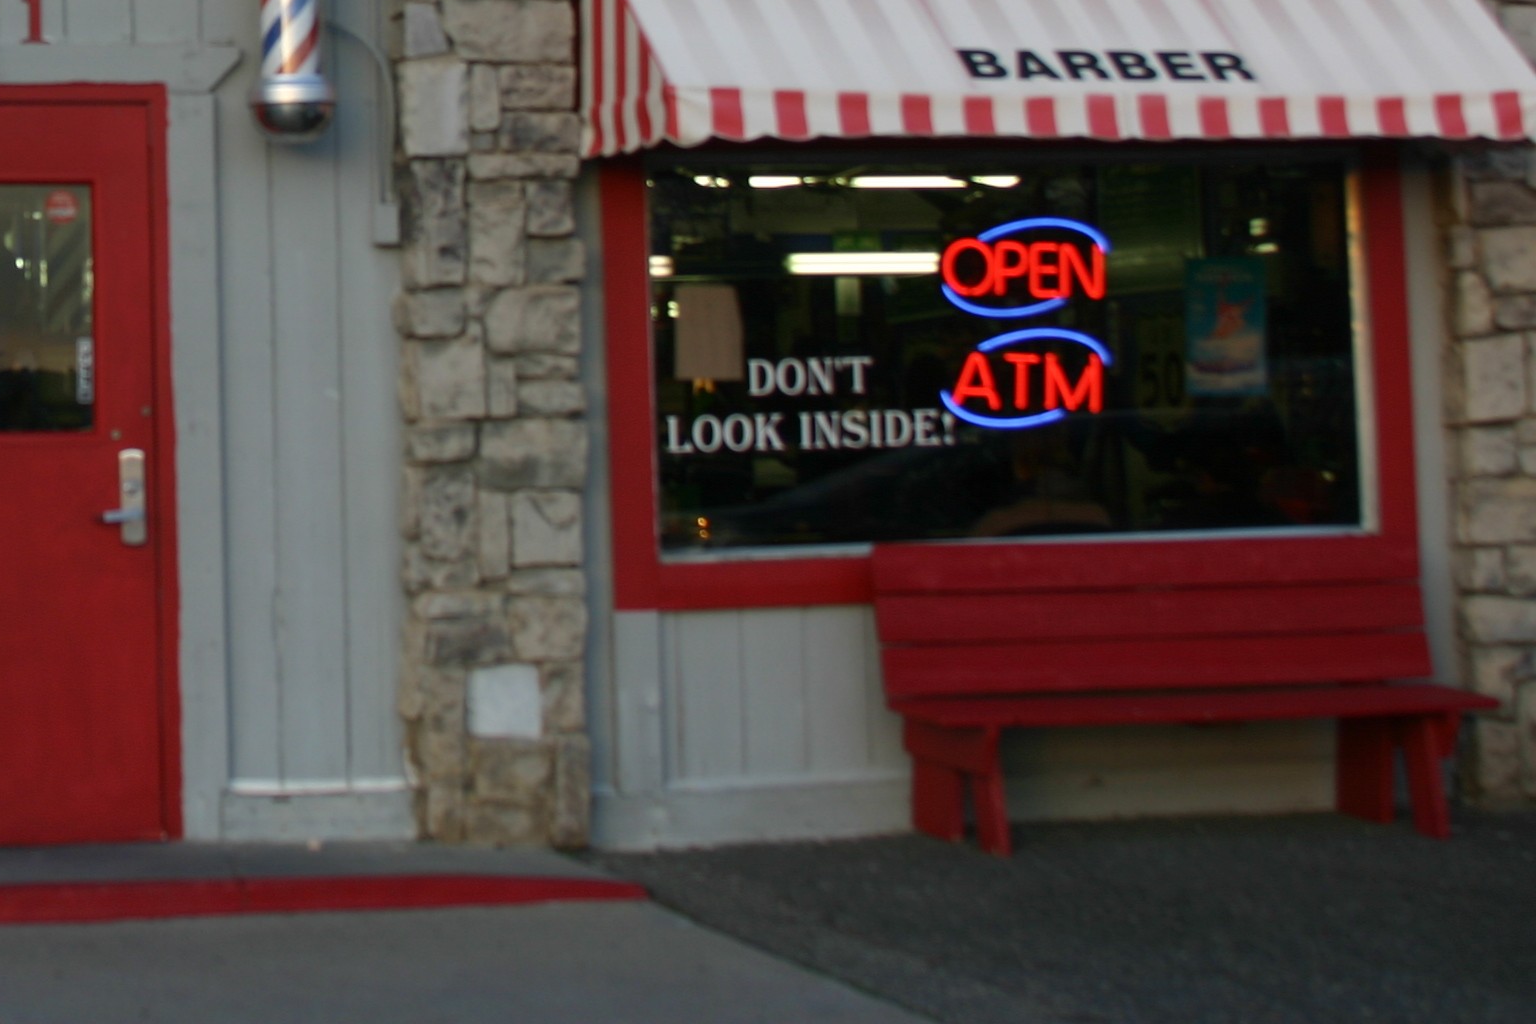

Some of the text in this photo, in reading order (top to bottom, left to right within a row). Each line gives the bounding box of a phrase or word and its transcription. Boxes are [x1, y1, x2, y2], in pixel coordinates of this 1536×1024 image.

[955, 48, 1259, 82] BARBER
[942, 237, 1106, 301] OPEN
[747, 355, 873, 396] DON'T
[951, 350, 1104, 414] ATM
[666, 407, 958, 454] LOOK INSIDE!
